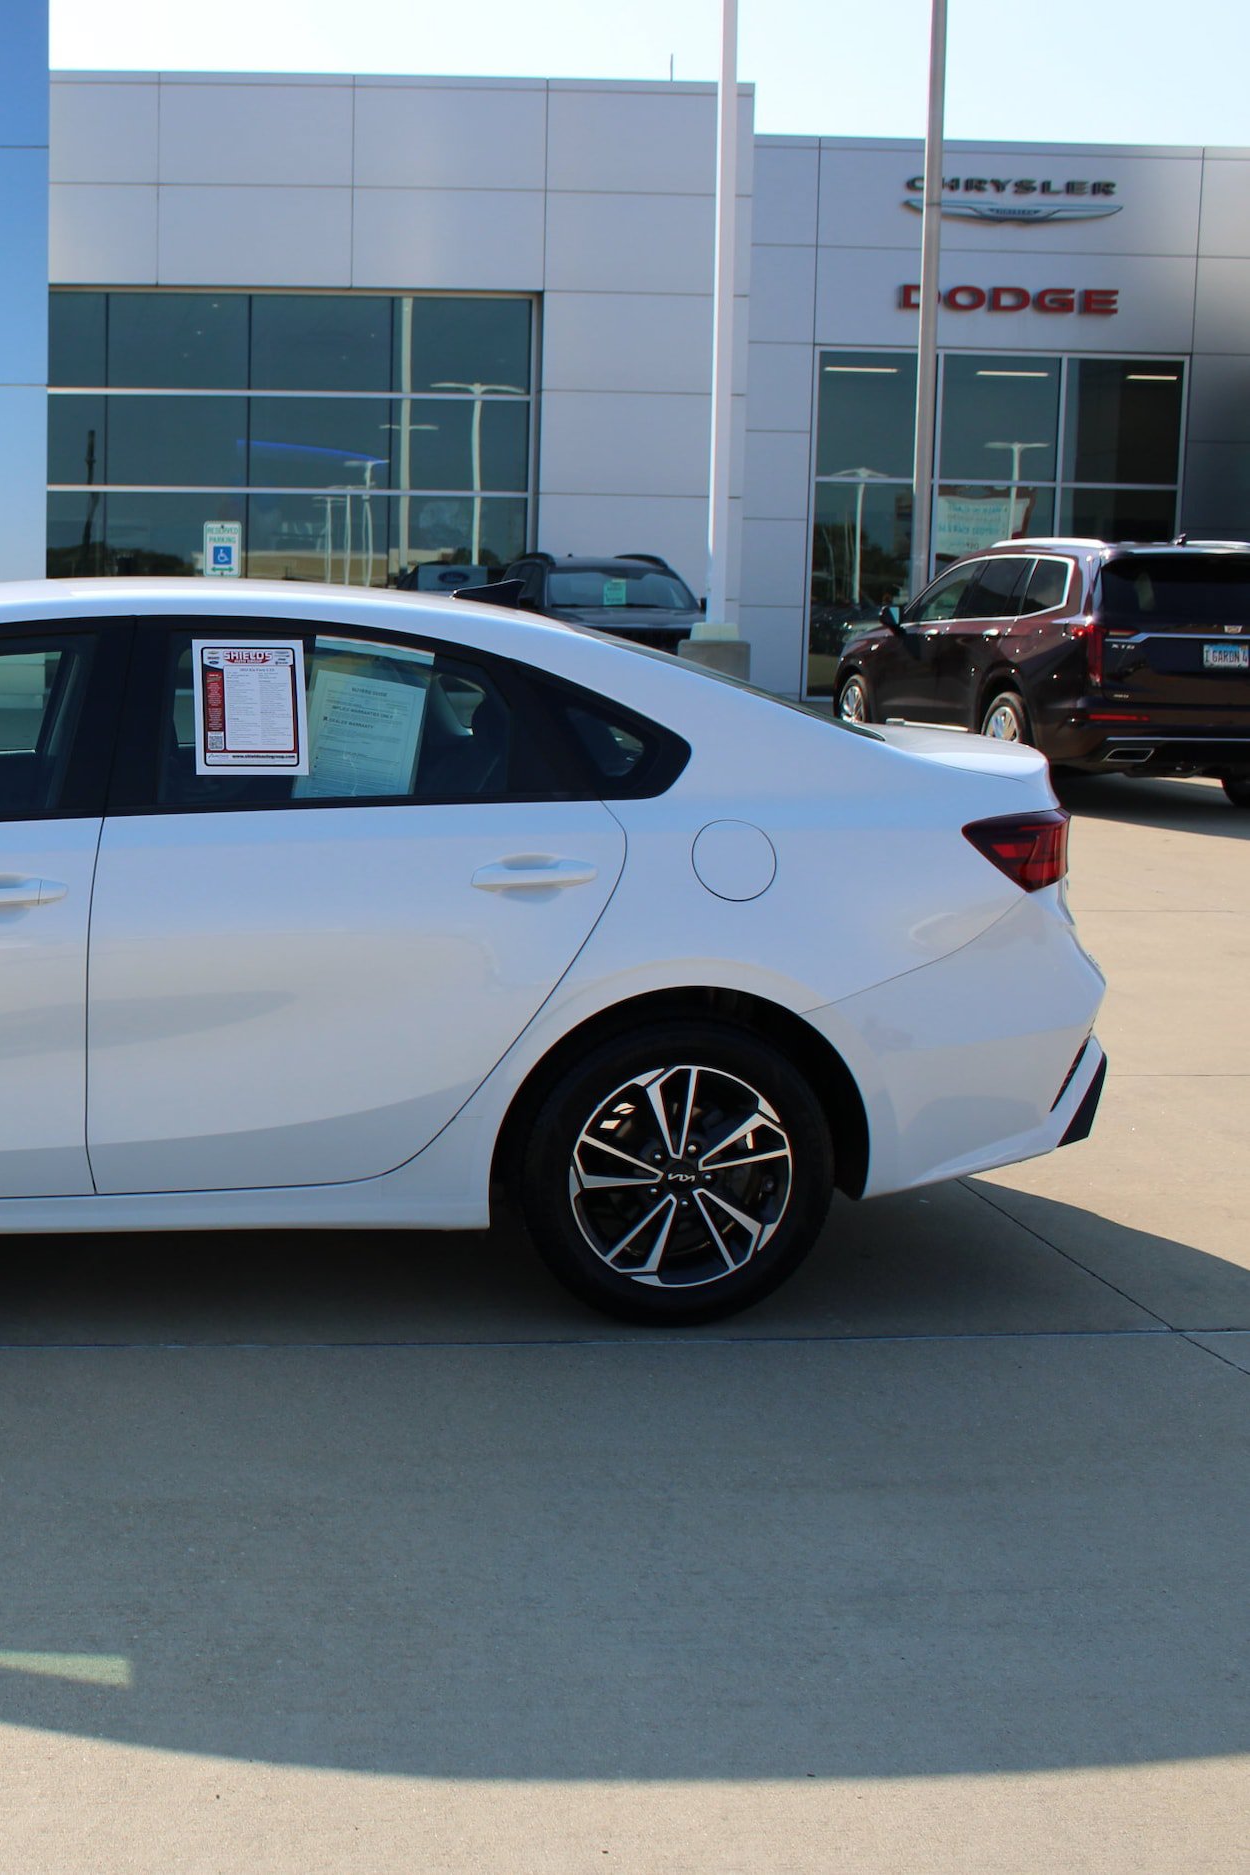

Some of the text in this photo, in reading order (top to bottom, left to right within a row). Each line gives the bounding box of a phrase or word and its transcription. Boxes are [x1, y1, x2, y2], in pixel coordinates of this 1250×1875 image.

[905, 176, 1117, 196] CHRYSLER
[901, 284, 1119, 316] DODGE
[223, 650, 273, 660] SHIELDS
